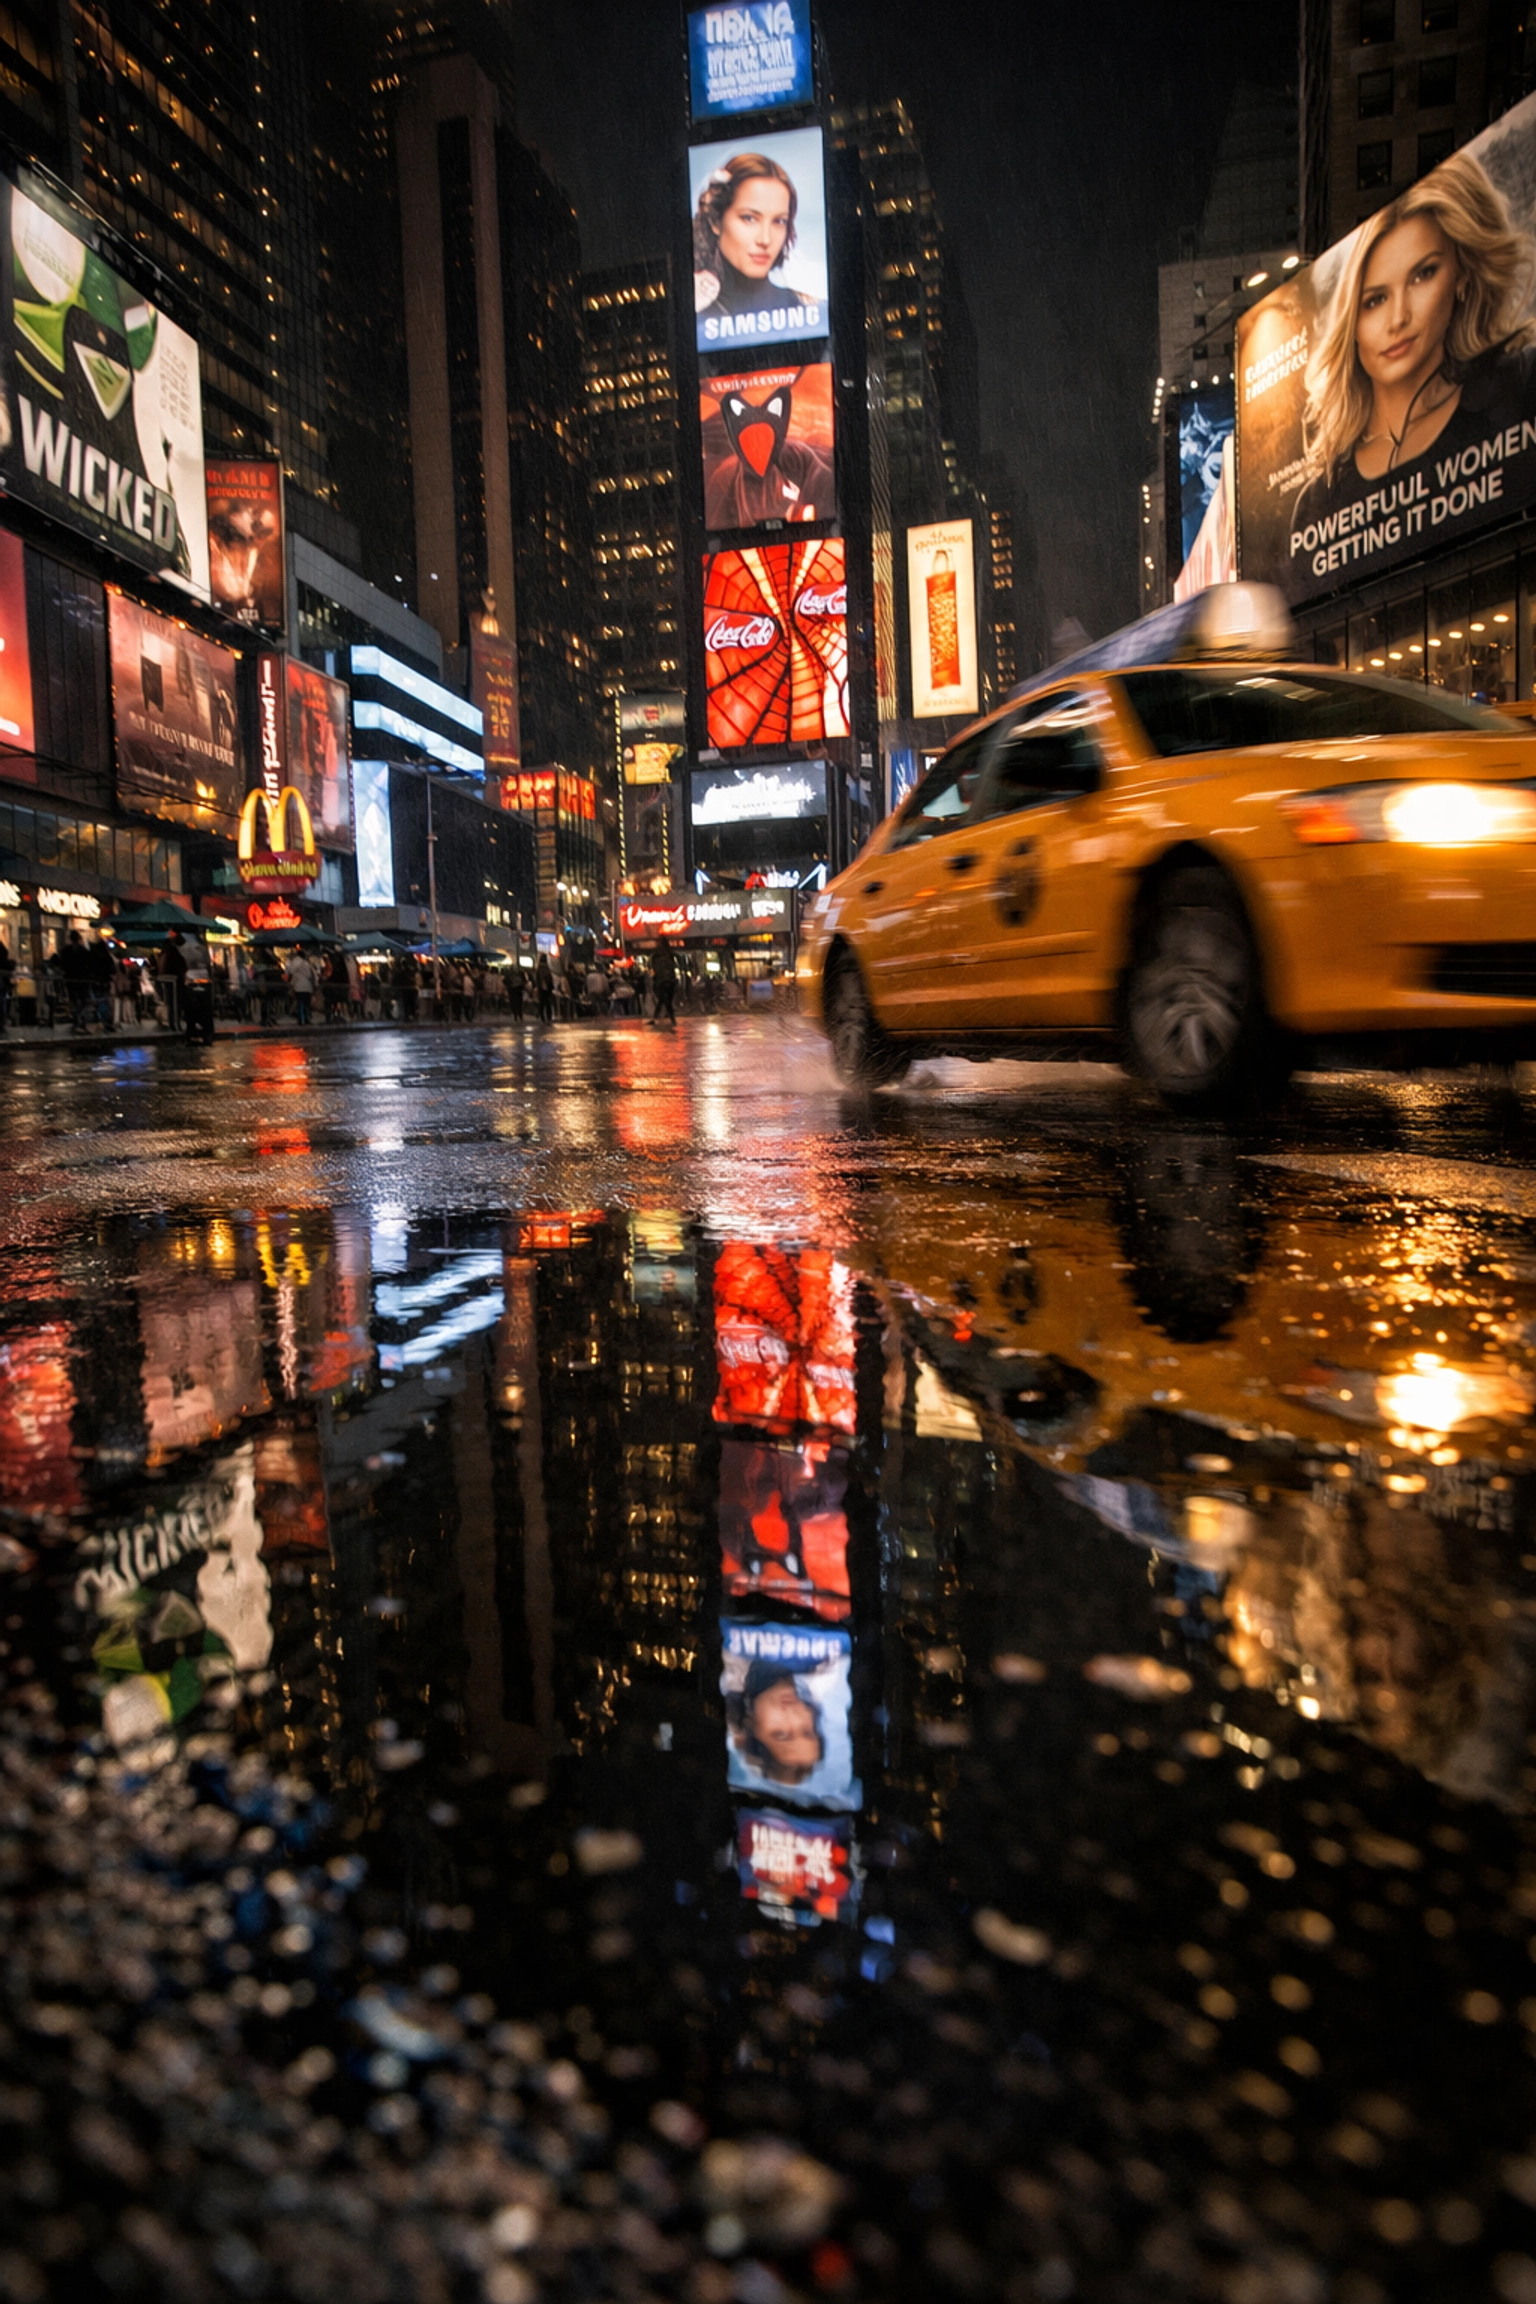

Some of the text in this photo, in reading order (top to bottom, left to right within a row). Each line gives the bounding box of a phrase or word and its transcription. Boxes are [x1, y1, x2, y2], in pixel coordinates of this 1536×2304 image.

[704, 305, 820, 340] SAMSUNG
[18, 394, 177, 552] WICKED
[1436, 415, 1536, 488] WOMEN
[1313, 468, 1503, 577] GETTING IT DONE
